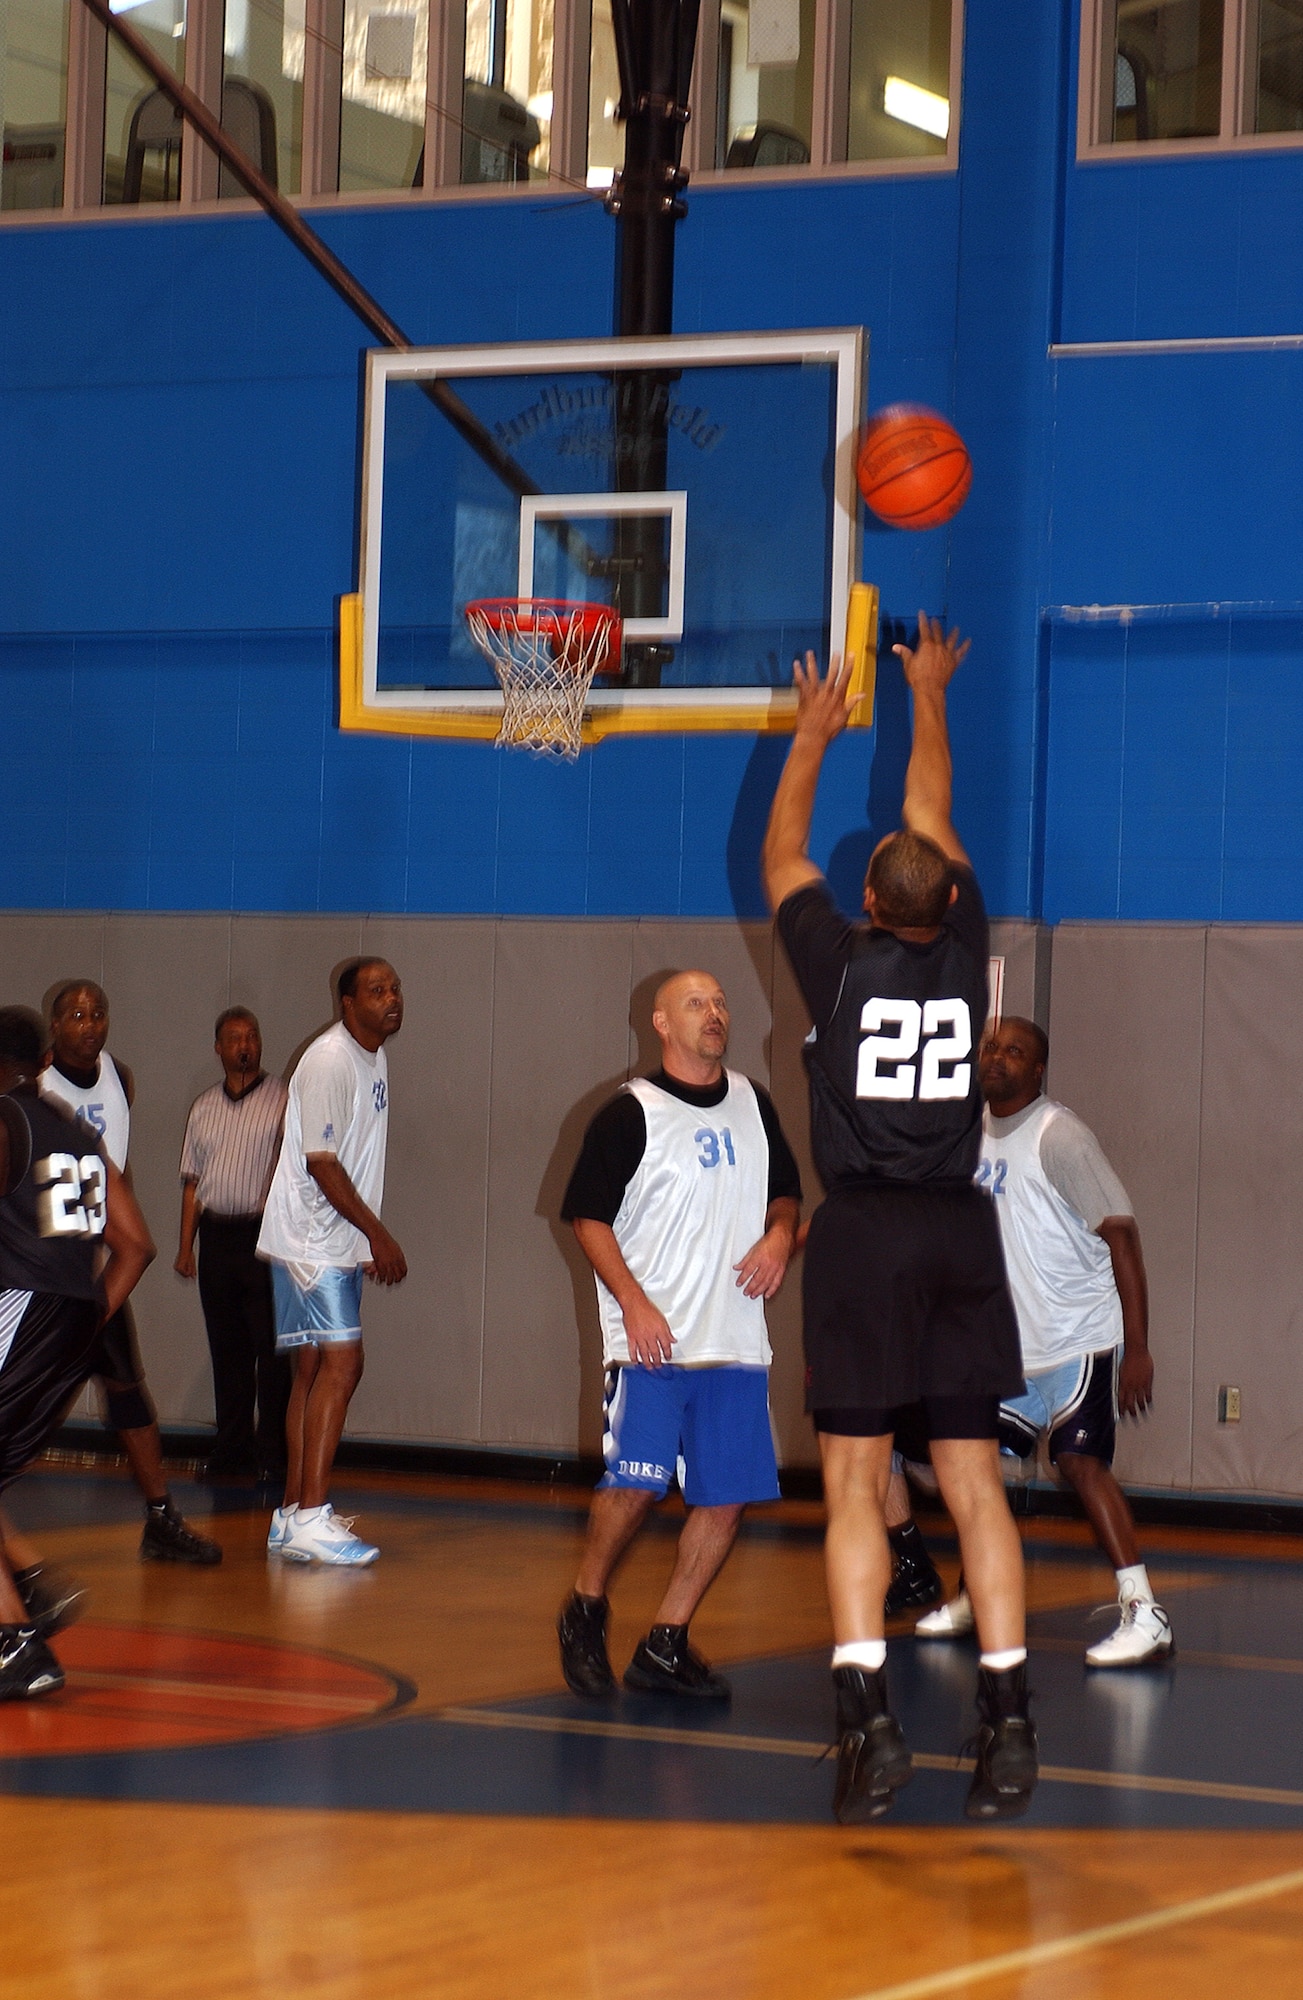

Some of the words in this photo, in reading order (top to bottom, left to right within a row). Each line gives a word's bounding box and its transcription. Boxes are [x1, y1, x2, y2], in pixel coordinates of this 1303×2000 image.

[856, 997, 972, 1101] 22
[694, 1127, 736, 1168] 31
[48, 1152, 107, 1235] 23
[977, 1157, 1009, 1195] 22
[617, 1460, 664, 1479] DUKE
